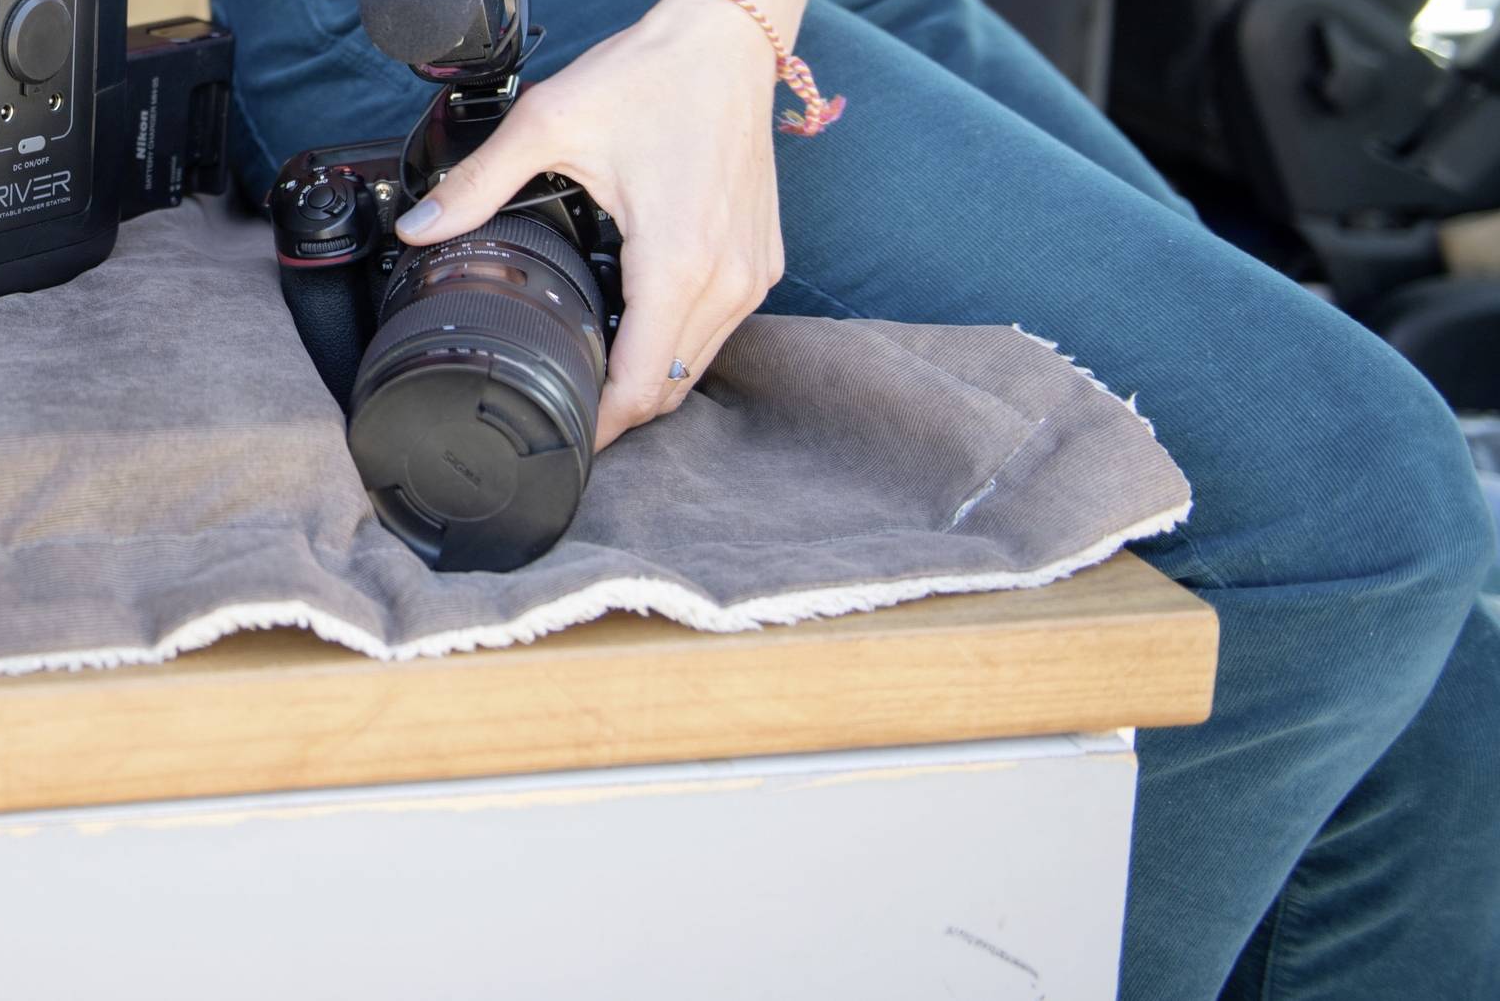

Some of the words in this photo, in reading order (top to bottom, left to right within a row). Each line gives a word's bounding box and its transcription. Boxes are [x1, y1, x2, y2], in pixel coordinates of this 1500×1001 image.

[136, 110, 148, 159] Nikon
[148, 106, 156, 150] CHARGER
[12, 163, 23, 172] DC
[24, 156, 50, 169] ON/OFF
[145, 151, 154, 190] BATTERY
[22, 202, 45, 213] POWER
[45, 196, 71, 208] STATION
